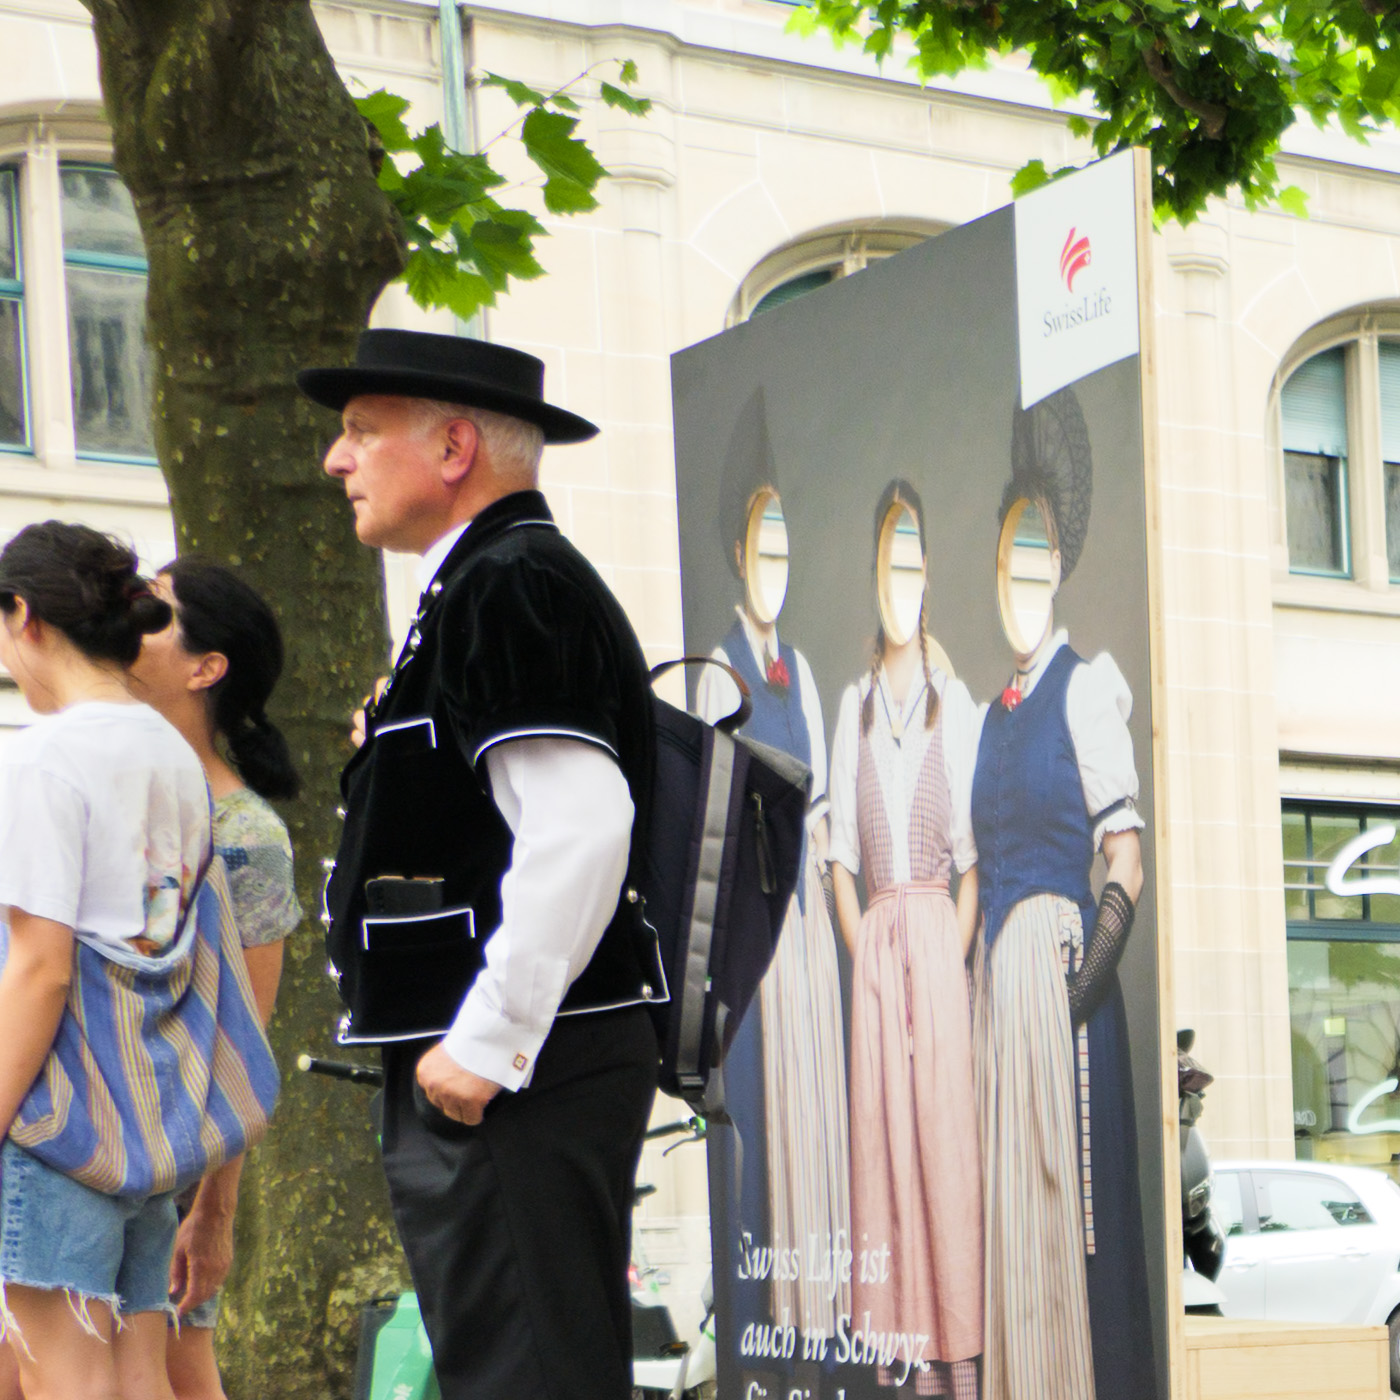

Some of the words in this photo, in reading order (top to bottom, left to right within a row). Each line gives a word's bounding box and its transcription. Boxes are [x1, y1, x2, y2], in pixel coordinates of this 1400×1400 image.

[1043, 286, 1112, 338] SwissLife
[738, 1232, 800, 1282] Swiss
[805, 1229, 853, 1301] Life
[859, 1233, 891, 1284] ist
[740, 1307, 798, 1359] auch
[802, 1309, 828, 1361] in
[835, 1311, 931, 1387] Schwyz
